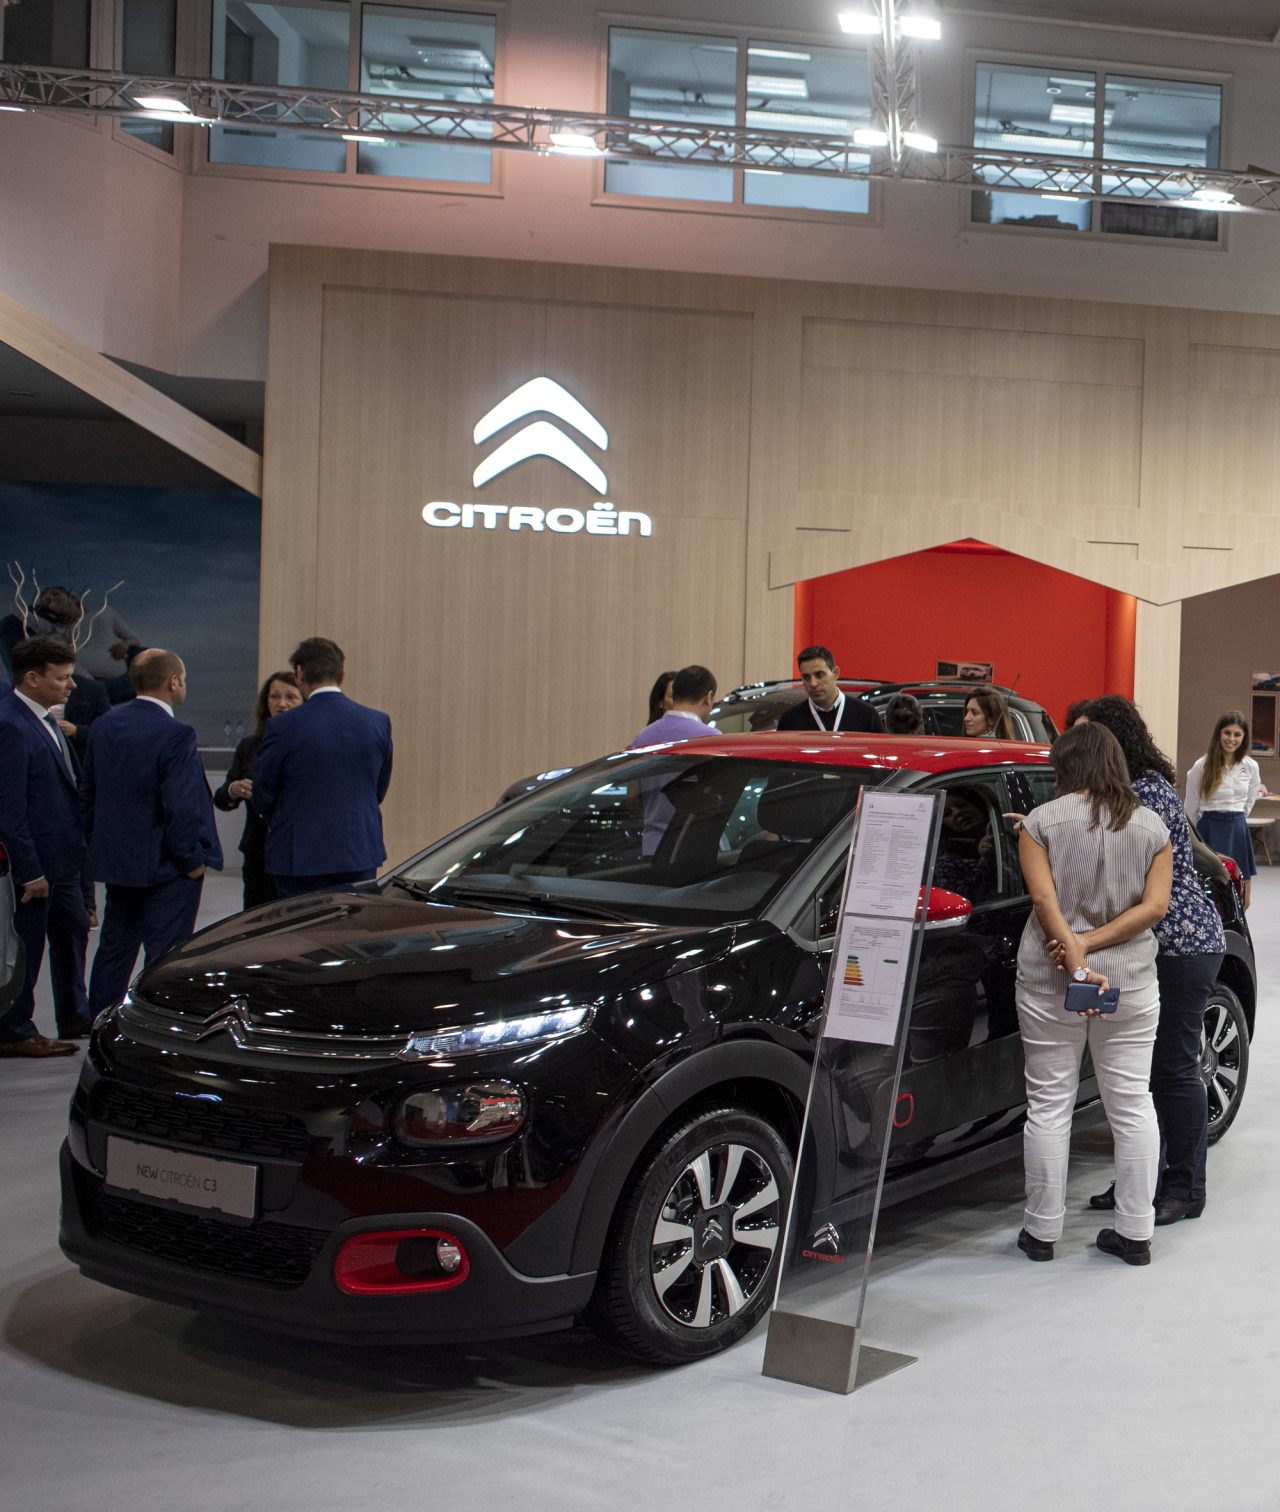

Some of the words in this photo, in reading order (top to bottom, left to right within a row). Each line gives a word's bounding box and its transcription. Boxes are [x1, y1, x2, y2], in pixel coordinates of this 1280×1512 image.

[136, 1163, 159, 1180] NEW
[160, 1169, 201, 1190] CITROËN
[203, 1178, 218, 1192] C3
